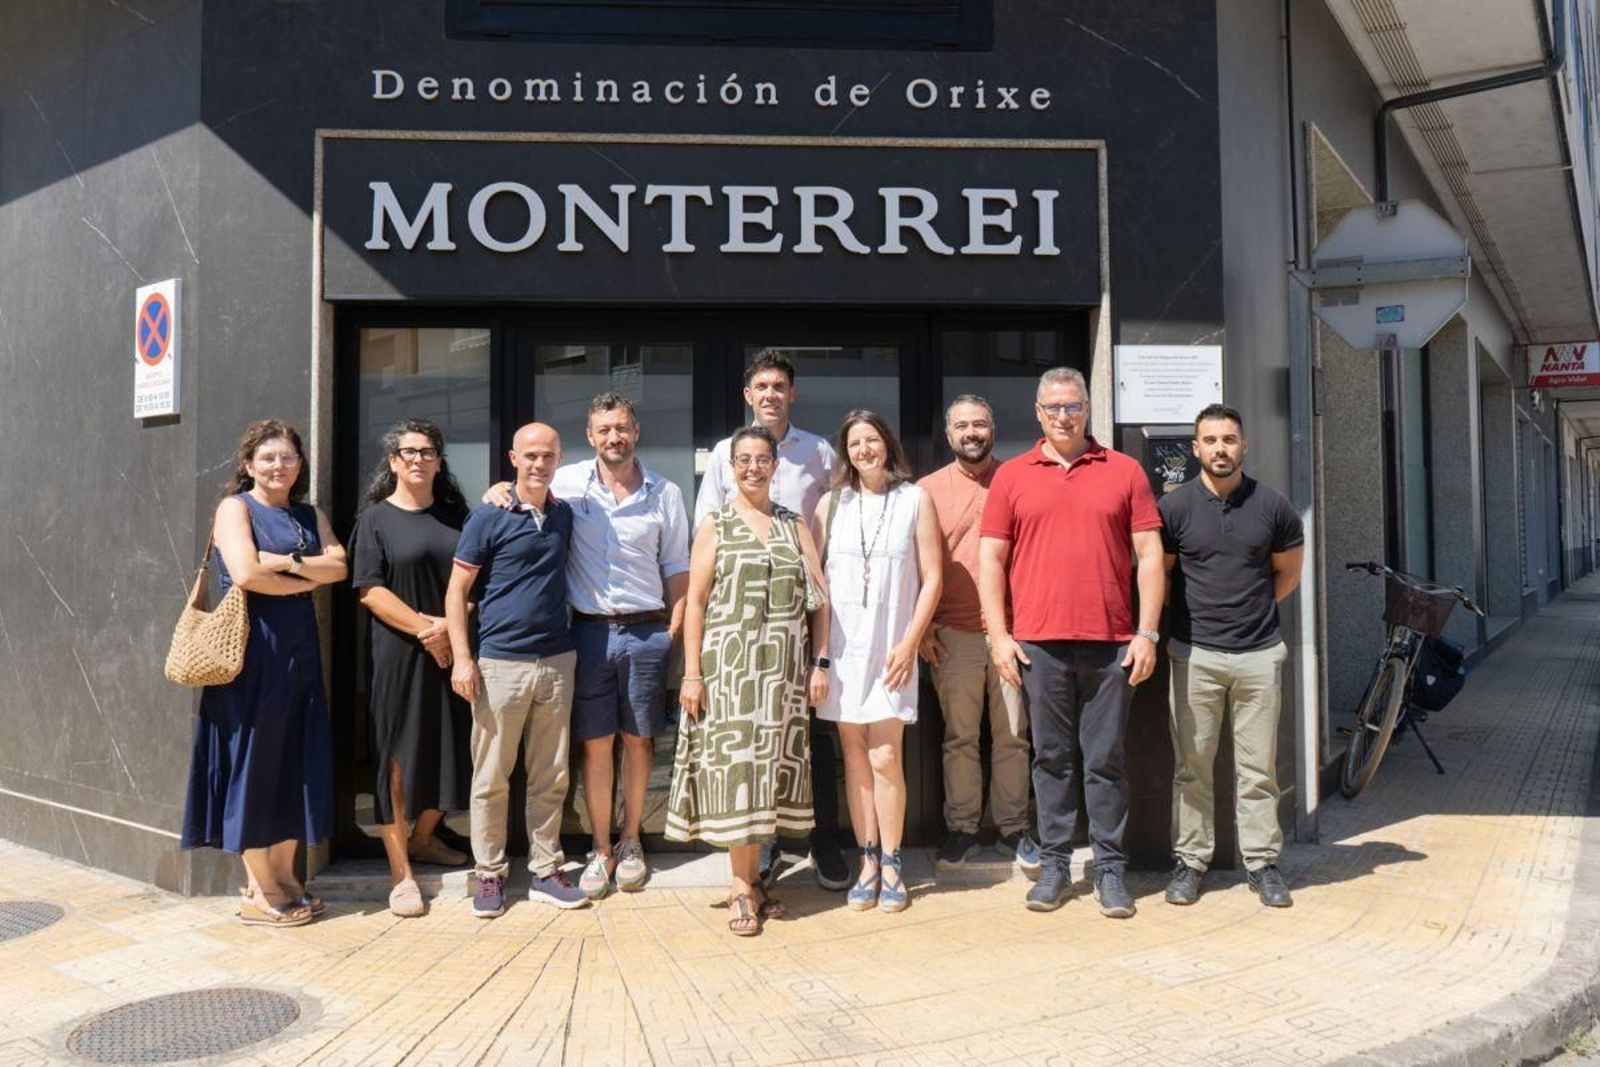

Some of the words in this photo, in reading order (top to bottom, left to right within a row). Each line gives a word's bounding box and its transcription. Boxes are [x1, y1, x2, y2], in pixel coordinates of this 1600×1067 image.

[372, 69, 779, 105] Denominación
[814, 75, 871, 107] de
[906, 78, 1051, 110] Orixe
[364, 181, 1061, 256] MONTERREI
[1540, 361, 1585, 372] NANTA
